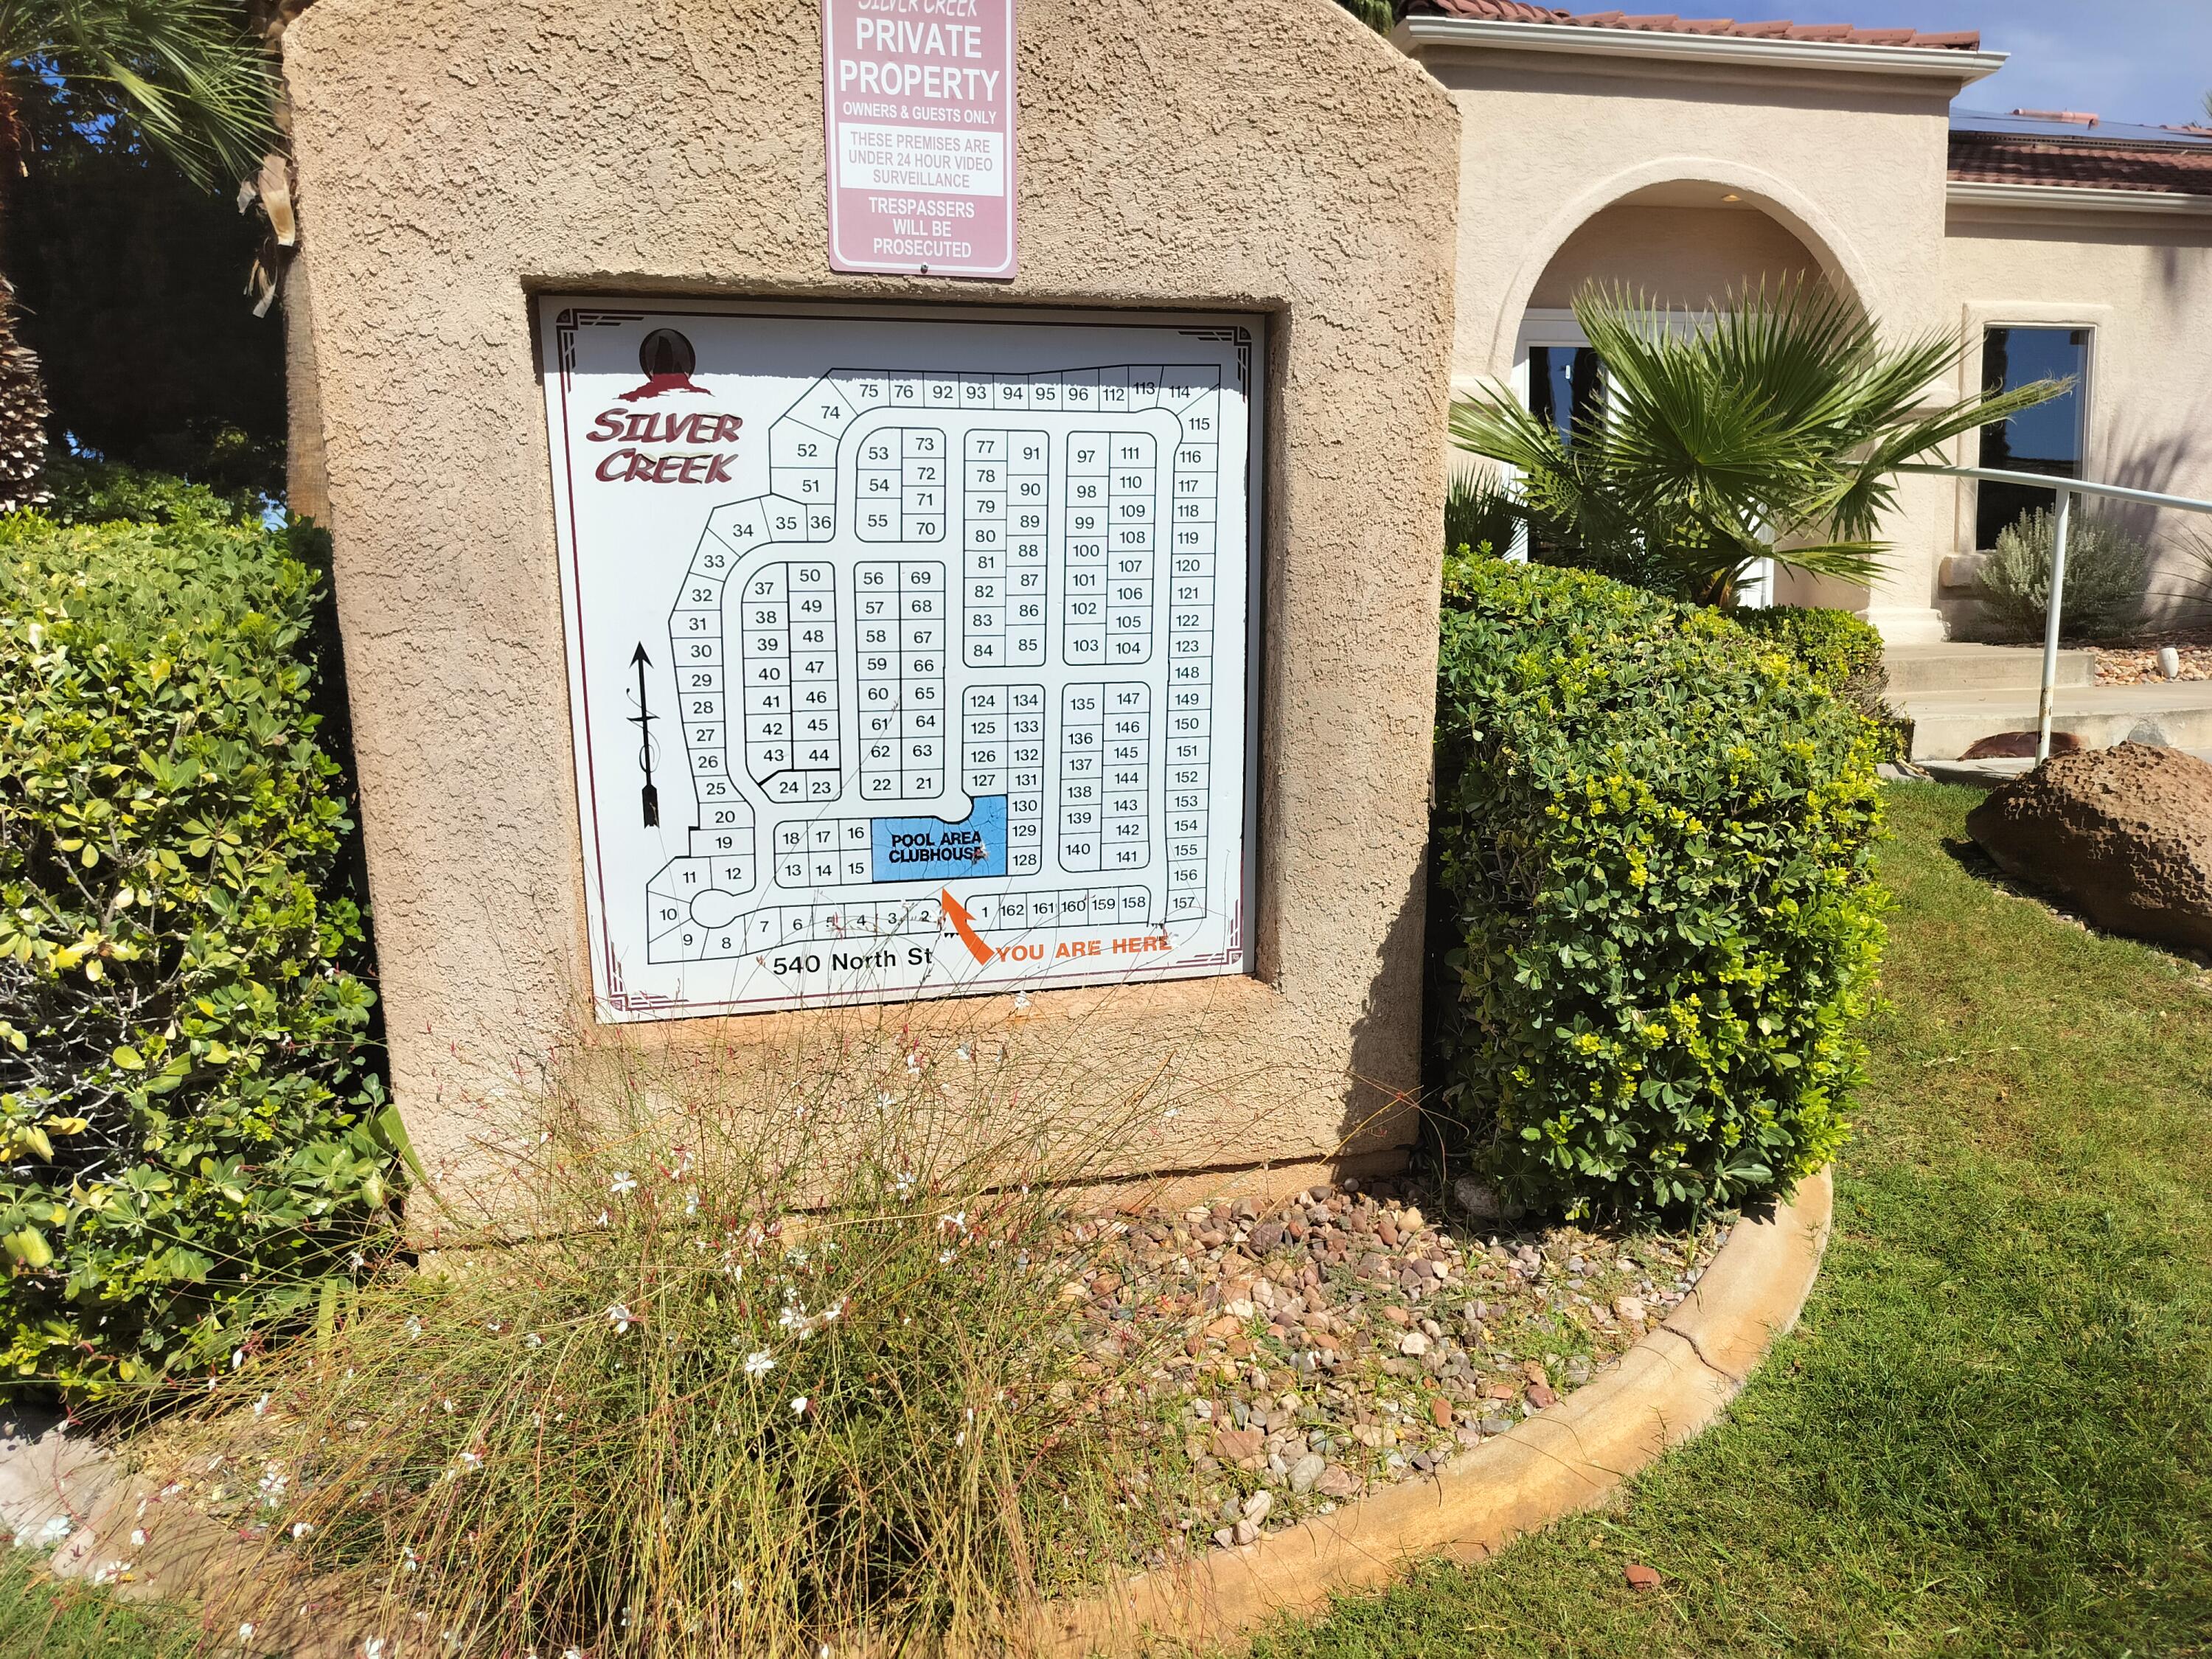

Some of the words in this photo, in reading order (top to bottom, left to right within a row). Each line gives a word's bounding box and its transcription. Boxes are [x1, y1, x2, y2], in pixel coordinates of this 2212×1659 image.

[856, 18, 982, 58] PRIVATE
[840, 59, 1000, 102] PROPERTY
[843, 102, 897, 119] OWNERS
[900, 105, 909, 119] &
[912, 107, 961, 123] GUESTS
[964, 110, 997, 125] ONLY
[850, 131, 893, 147] THESE
[897, 134, 961, 152] PREMISES
[964, 139, 990, 153] ARE
[849, 150, 893, 166] UNDER
[897, 153, 911, 167] 24
[914, 154, 951, 170] HOUR
[955, 156, 993, 172] VIDEO
[873, 169, 970, 188] SURVEILLANCE
[869, 196, 975, 218] TRESPASSERS
[893, 218, 928, 237] WILL
[932, 221, 952, 237] BE
[873, 237, 972, 258] PROSECUTED
[859, 384, 878, 397] 75
[966, 386, 986, 399] 93
[1003, 387, 1023, 400] 94
[1035, 388, 1055, 400] 95
[1133, 382, 1155, 394] 113
[1169, 386, 1190, 398] 114
[821, 406, 840, 419] 74
[586, 408, 743, 443] SILVER
[1188, 418, 1209, 430] 115
[915, 438, 933, 451] 73
[976, 441, 995, 453] 77
[868, 447, 888, 459] 53
[1023, 447, 1039, 459] 91
[1077, 451, 1095, 462] 97
[1120, 448, 1138, 459] 111
[595, 448, 738, 484] CREEK
[976, 470, 995, 482] 78
[1119, 476, 1141, 488] 110
[801, 480, 818, 493] 51
[869, 479, 889, 491] 54
[1020, 483, 1040, 495] 90
[1178, 480, 1198, 492] 117
[1077, 485, 1096, 498] 98
[917, 493, 932, 506] 71
[976, 501, 995, 512] 79
[1119, 505, 1145, 517] 109
[1177, 505, 1198, 517] 118
[776, 517, 796, 529] 35
[867, 515, 888, 526] 55
[1020, 515, 1039, 527] 89
[1075, 517, 1094, 529] 99
[732, 524, 754, 537] 34
[916, 523, 935, 535] 70
[1177, 532, 1198, 544] 119
[703, 555, 725, 568] 33
[978, 556, 993, 568] 81
[1118, 560, 1142, 572] 107
[799, 569, 820, 582] 50
[911, 571, 931, 584] 69
[1020, 574, 1038, 586] 87
[1072, 574, 1094, 586] 101
[754, 582, 773, 594] 37
[974, 585, 993, 597] 82
[1116, 588, 1142, 599] 106
[1178, 588, 1197, 599] 121
[801, 600, 821, 613] 49
[865, 602, 883, 613] 57
[1019, 605, 1038, 616] 86
[1071, 602, 1096, 614] 102
[755, 611, 776, 624] 38
[973, 614, 992, 626] 83
[1116, 616, 1141, 627] 105
[1176, 615, 1199, 626] 122
[689, 618, 706, 630] 31
[866, 630, 886, 642] 58
[914, 631, 932, 643] 67
[757, 639, 778, 650] 39
[1018, 639, 1037, 651] 85
[1073, 640, 1098, 651] 103
[1175, 640, 1198, 652] 123
[690, 644, 712, 658] 30
[804, 661, 824, 673] 47
[867, 658, 886, 670] 59
[914, 660, 933, 672] 66
[691, 674, 712, 686] 29
[805, 691, 827, 703] 46
[914, 687, 934, 699] 65
[1116, 693, 1139, 704] 147
[1175, 693, 1198, 705] 149
[762, 696, 779, 708] 41
[1012, 695, 1038, 706] 134
[1070, 698, 1094, 710] 135
[762, 723, 782, 735] 42
[807, 719, 827, 731] 45
[872, 718, 887, 730] 61
[970, 722, 995, 734] 125
[1013, 721, 1038, 733] 133
[1115, 721, 1139, 733] 146
[1174, 718, 1199, 729] 150
[696, 729, 714, 741] 27
[763, 749, 784, 762] 43
[870, 745, 890, 758] 62
[912, 745, 932, 757] 63
[970, 751, 995, 762] 126
[1113, 747, 1138, 758] 145
[1176, 745, 1197, 757] 151
[698, 756, 718, 768] 26
[1068, 759, 1092, 771] 137
[872, 779, 891, 790] 22
[916, 778, 931, 789] 21
[972, 774, 995, 786] 127
[1015, 774, 1036, 786] 131
[706, 783, 726, 795] 25
[812, 782, 831, 794] 23
[1067, 786, 1091, 798] 138
[1012, 800, 1037, 812] 130
[1113, 799, 1137, 811] 143
[1174, 796, 1197, 807] 153
[1066, 813, 1091, 824] 139
[1012, 825, 1036, 836] 129
[1116, 824, 1138, 835] 142
[1174, 820, 1197, 831] 154
[714, 837, 732, 849] 19
[782, 832, 800, 844] 18
[815, 831, 830, 843] 17
[891, 833, 935, 847] POOL
[940, 831, 981, 846] AREA
[888, 846, 984, 863] CLUBHOUSE
[1174, 844, 1197, 855] 155
[1116, 851, 1136, 863] 141
[785, 865, 801, 876] 13
[815, 865, 832, 876] 14
[847, 863, 864, 874] 15
[682, 872, 695, 883] 11
[1032, 902, 1053, 914] 161
[1091, 899, 1115, 910] 159
[1121, 897, 1145, 908] 158
[1172, 897, 1194, 909] 157
[659, 908, 677, 920] 10
[981, 907, 987, 917] 1
[1000, 904, 1024, 917] 162
[886, 913, 897, 924] 3
[759, 921, 768, 932] 7
[793, 919, 803, 931] 6
[683, 934, 692, 946] 9
[995, 944, 1044, 962] YOU
[1055, 940, 1102, 959] ARE
[1113, 936, 1172, 954] HERE
[773, 955, 821, 975] 540
[832, 950, 896, 970] North
[908, 947, 932, 966] St
